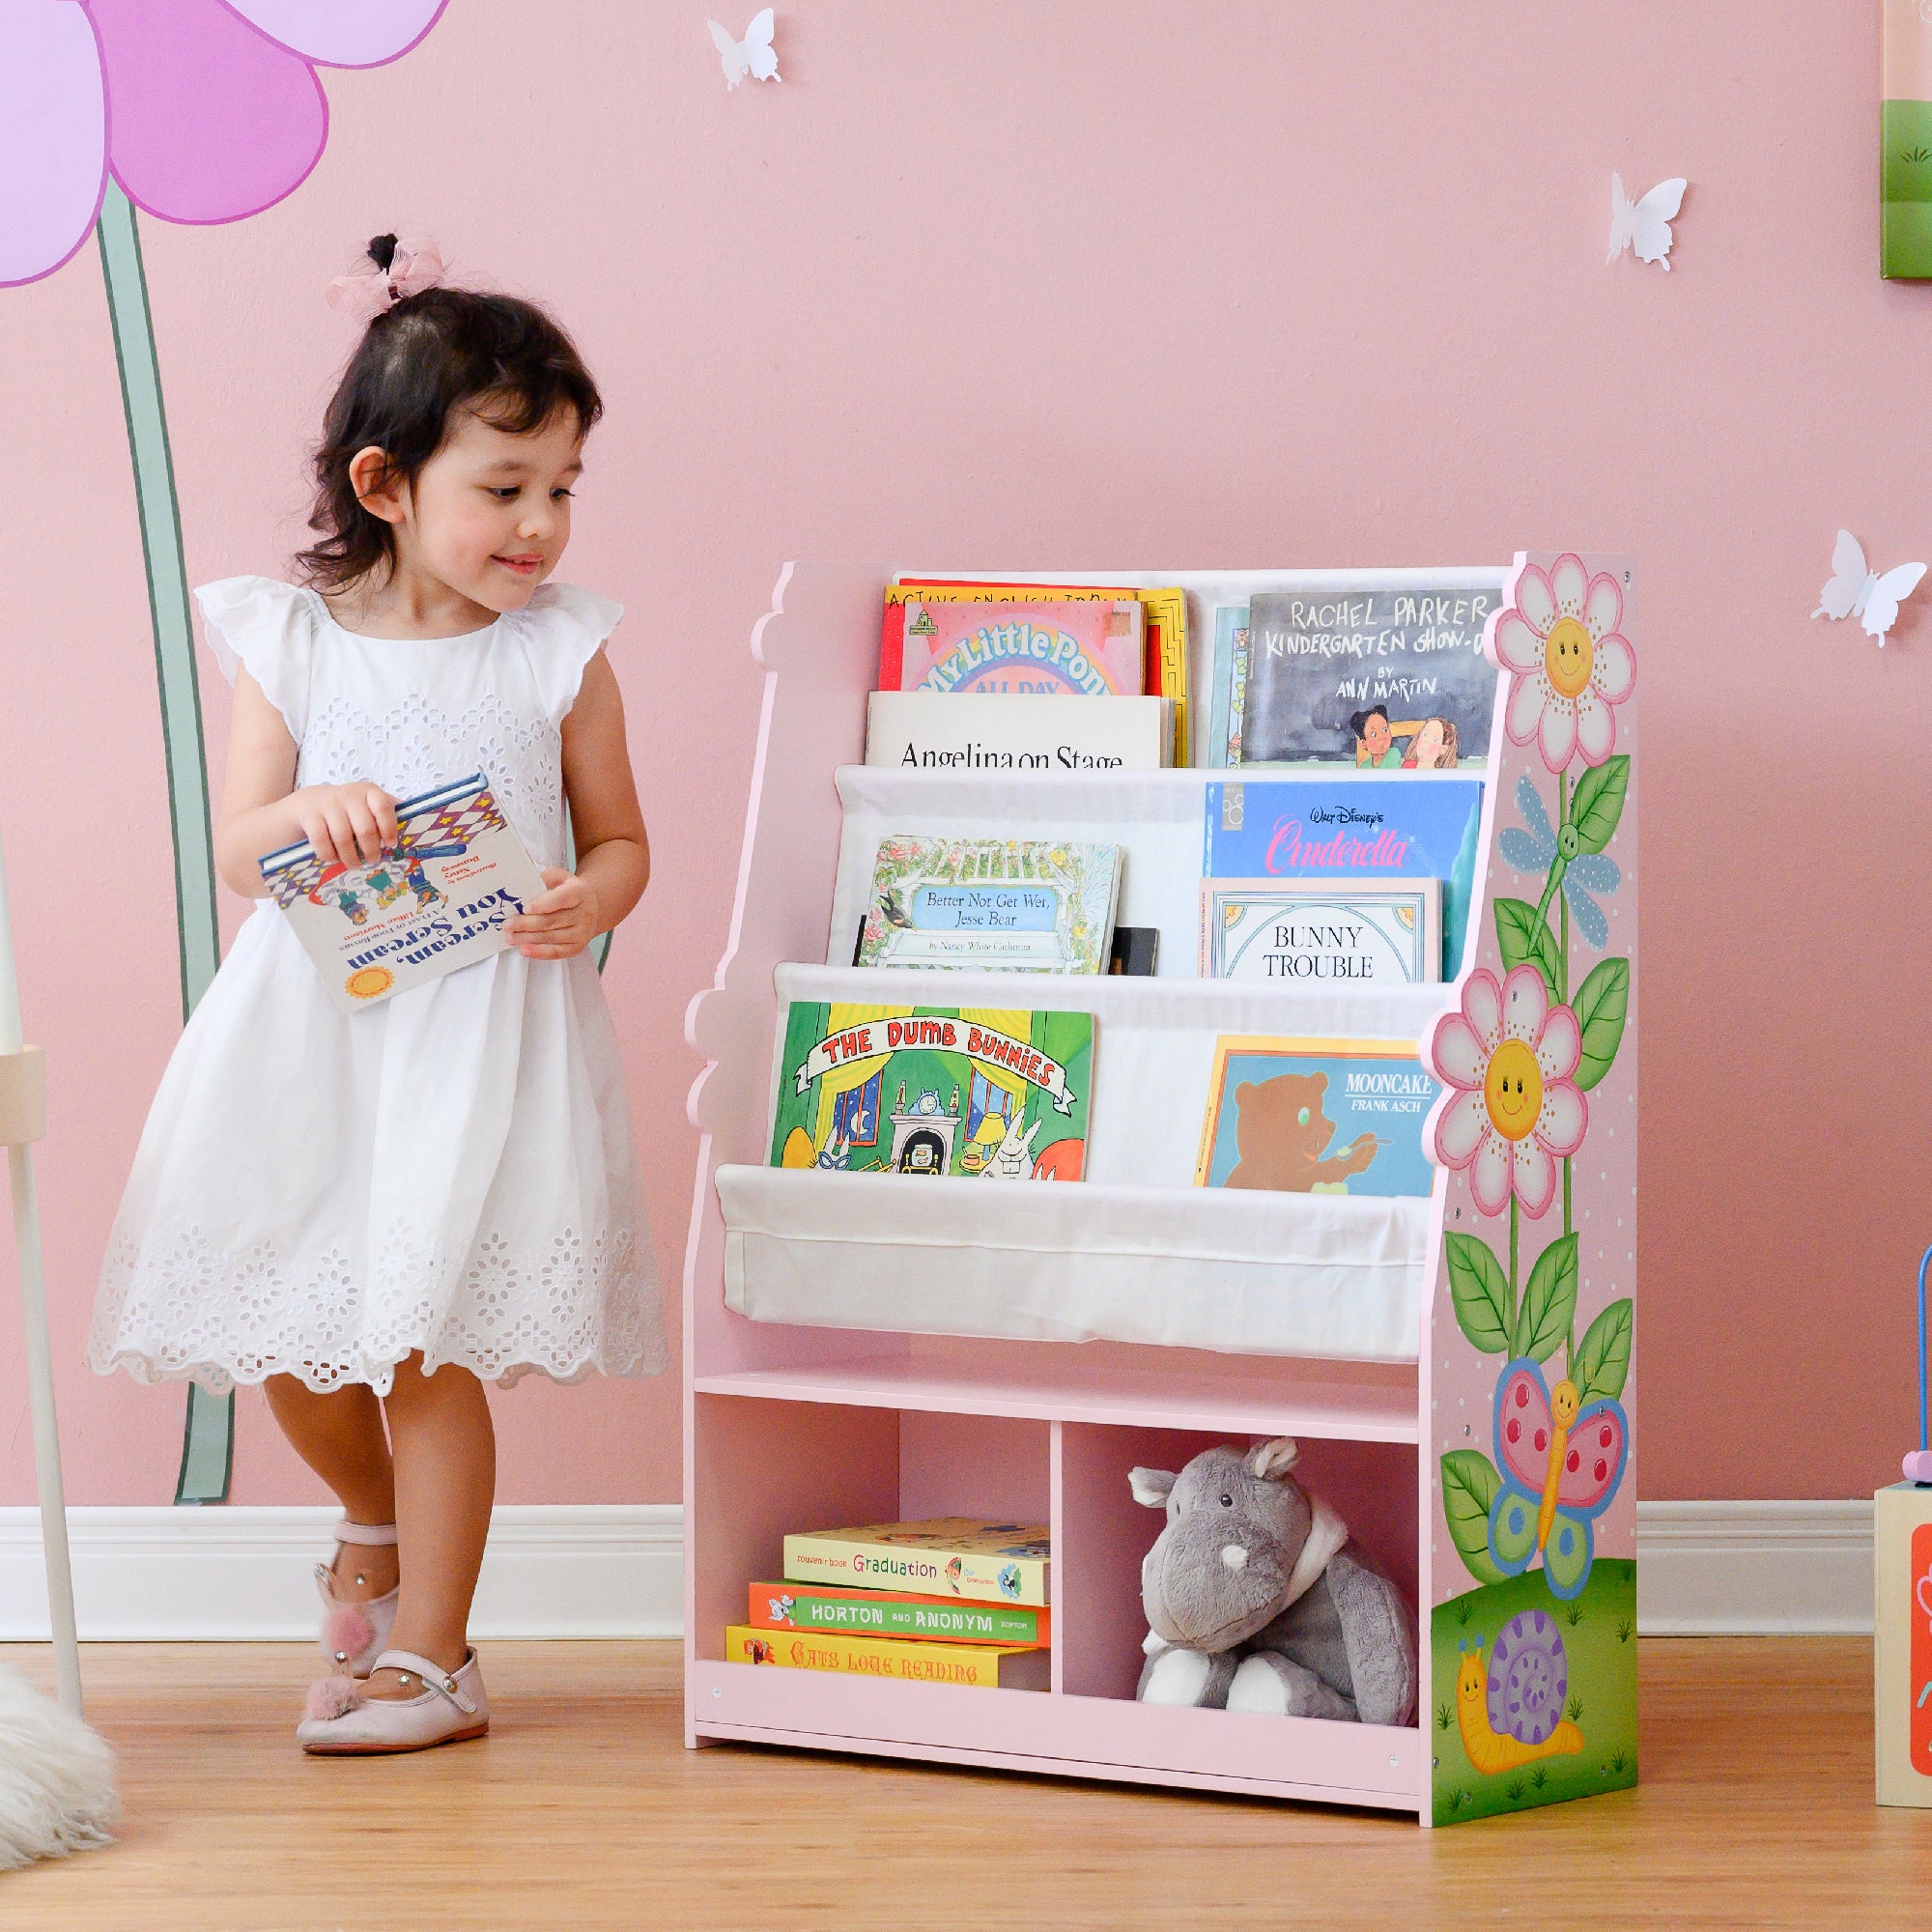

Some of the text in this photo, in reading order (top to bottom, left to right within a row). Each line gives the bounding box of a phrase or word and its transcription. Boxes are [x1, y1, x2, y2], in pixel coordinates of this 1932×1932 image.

[1291, 595, 1489, 629] RACHEL PARKER
[1264, 629, 1406, 660] KINDERGARTEN
[957, 622, 1051, 670] Little
[1050, 631, 1112, 696] Pon
[1378, 666, 1394, 678] BY
[1335, 676, 1437, 702] ANN MARTIN
[1018, 753, 1049, 768] on
[1265, 813, 1409, 874] Cinderella
[927, 892, 1050, 910] Better Not Get Wet,
[348, 887, 523, 969] You Scream
[954, 911, 1017, 927] Jesse Bear
[1273, 926, 1363, 948] BUNNY
[1262, 955, 1374, 979] TROUBLE
[822, 1029, 872, 1064] THE
[1346, 1073, 1432, 1094] MOONCAKE
[1351, 1099, 1421, 1113] FRANK ASCH
[853, 1554, 937, 1577] Graduation
[811, 1604, 884, 1625] HORTON
[892, 1613, 911, 1623] AND
[916, 1610, 993, 1632] ANONYM
